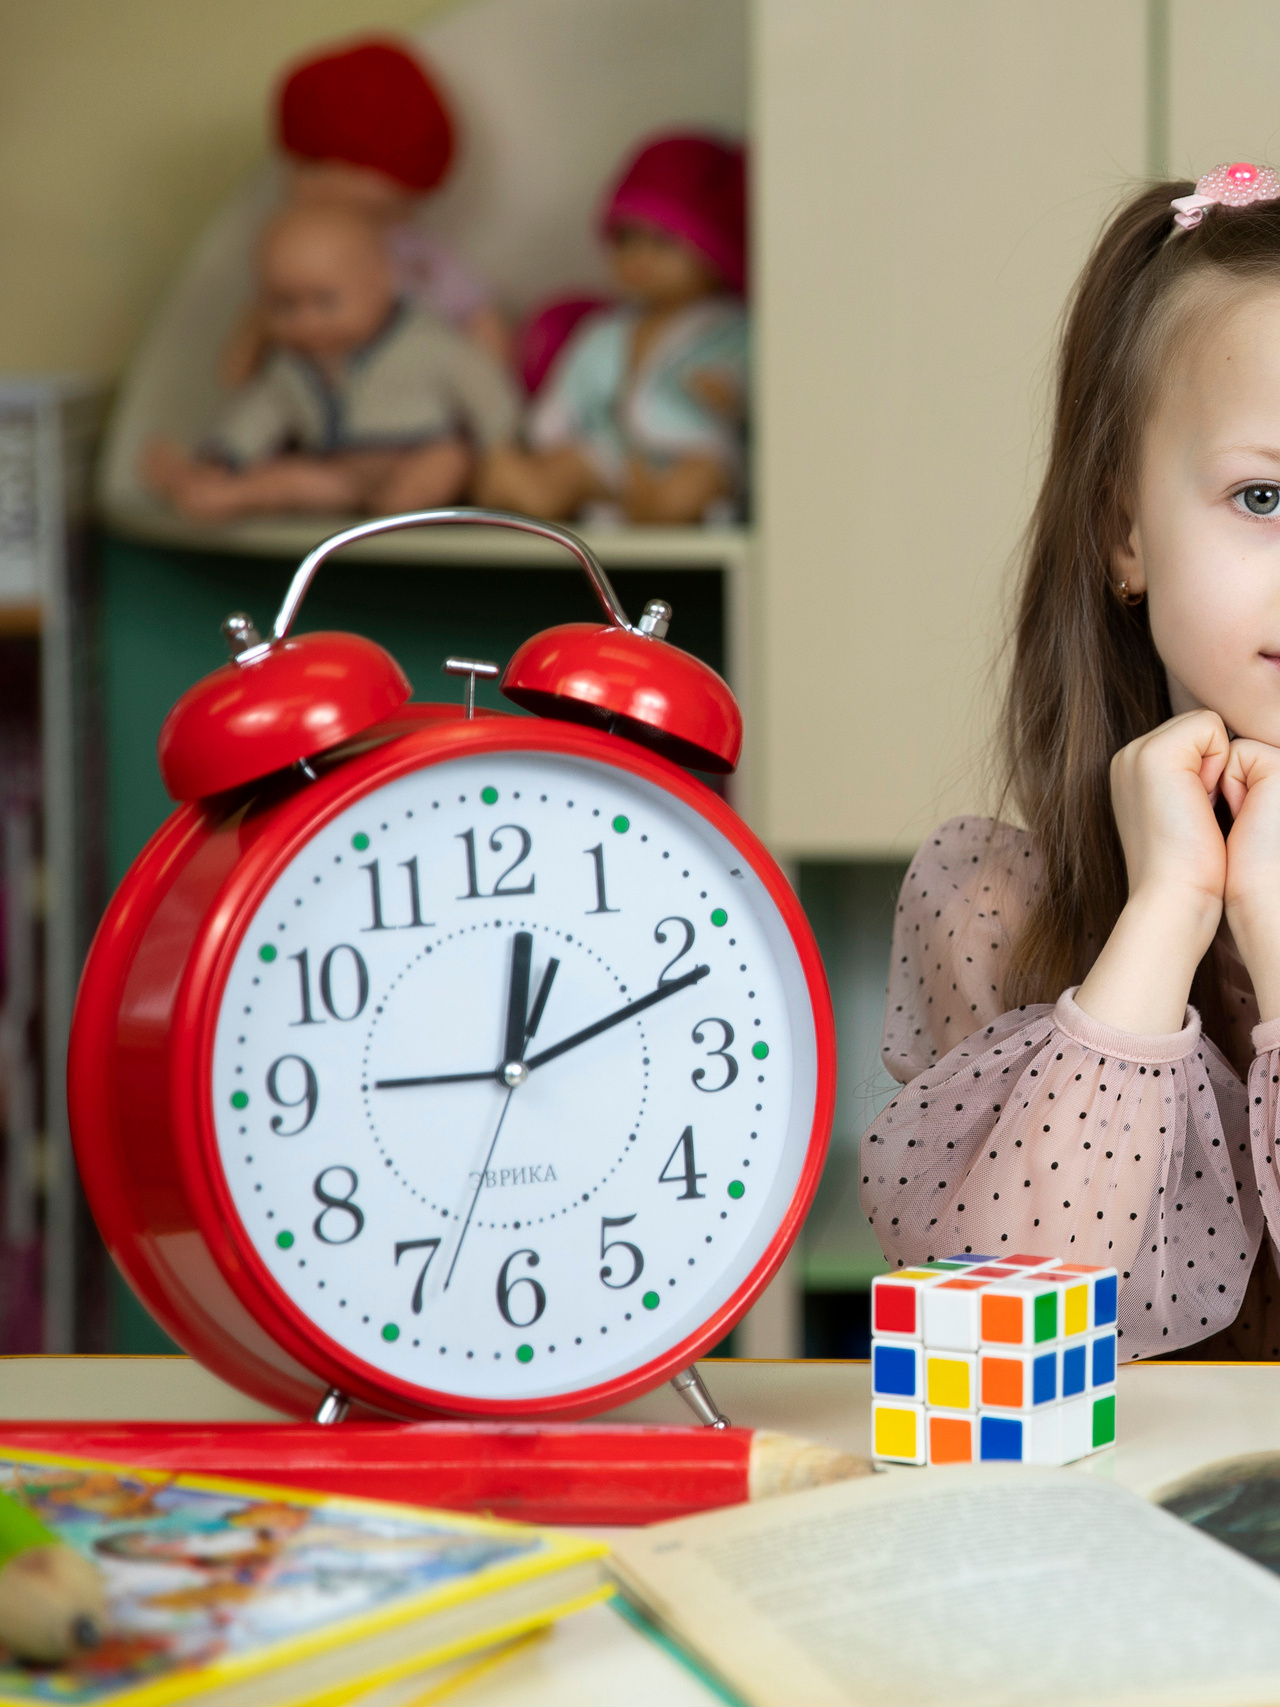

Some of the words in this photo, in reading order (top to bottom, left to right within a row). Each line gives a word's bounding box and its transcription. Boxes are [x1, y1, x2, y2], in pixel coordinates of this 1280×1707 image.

[359, 855, 436, 932] 11
[454, 824, 535, 900] 12
[583, 842, 620, 914] 1
[288, 944, 369, 1026] 10
[654, 916, 698, 988] 2
[691, 1017, 739, 1093] 3
[265, 1054, 319, 1136] 9
[657, 1125, 707, 1201] 4
[312, 1165, 365, 1245] 8
[394, 1237, 442, 1315] 7
[495, 1249, 547, 1328] 6
[599, 1212, 649, 1290] 5
